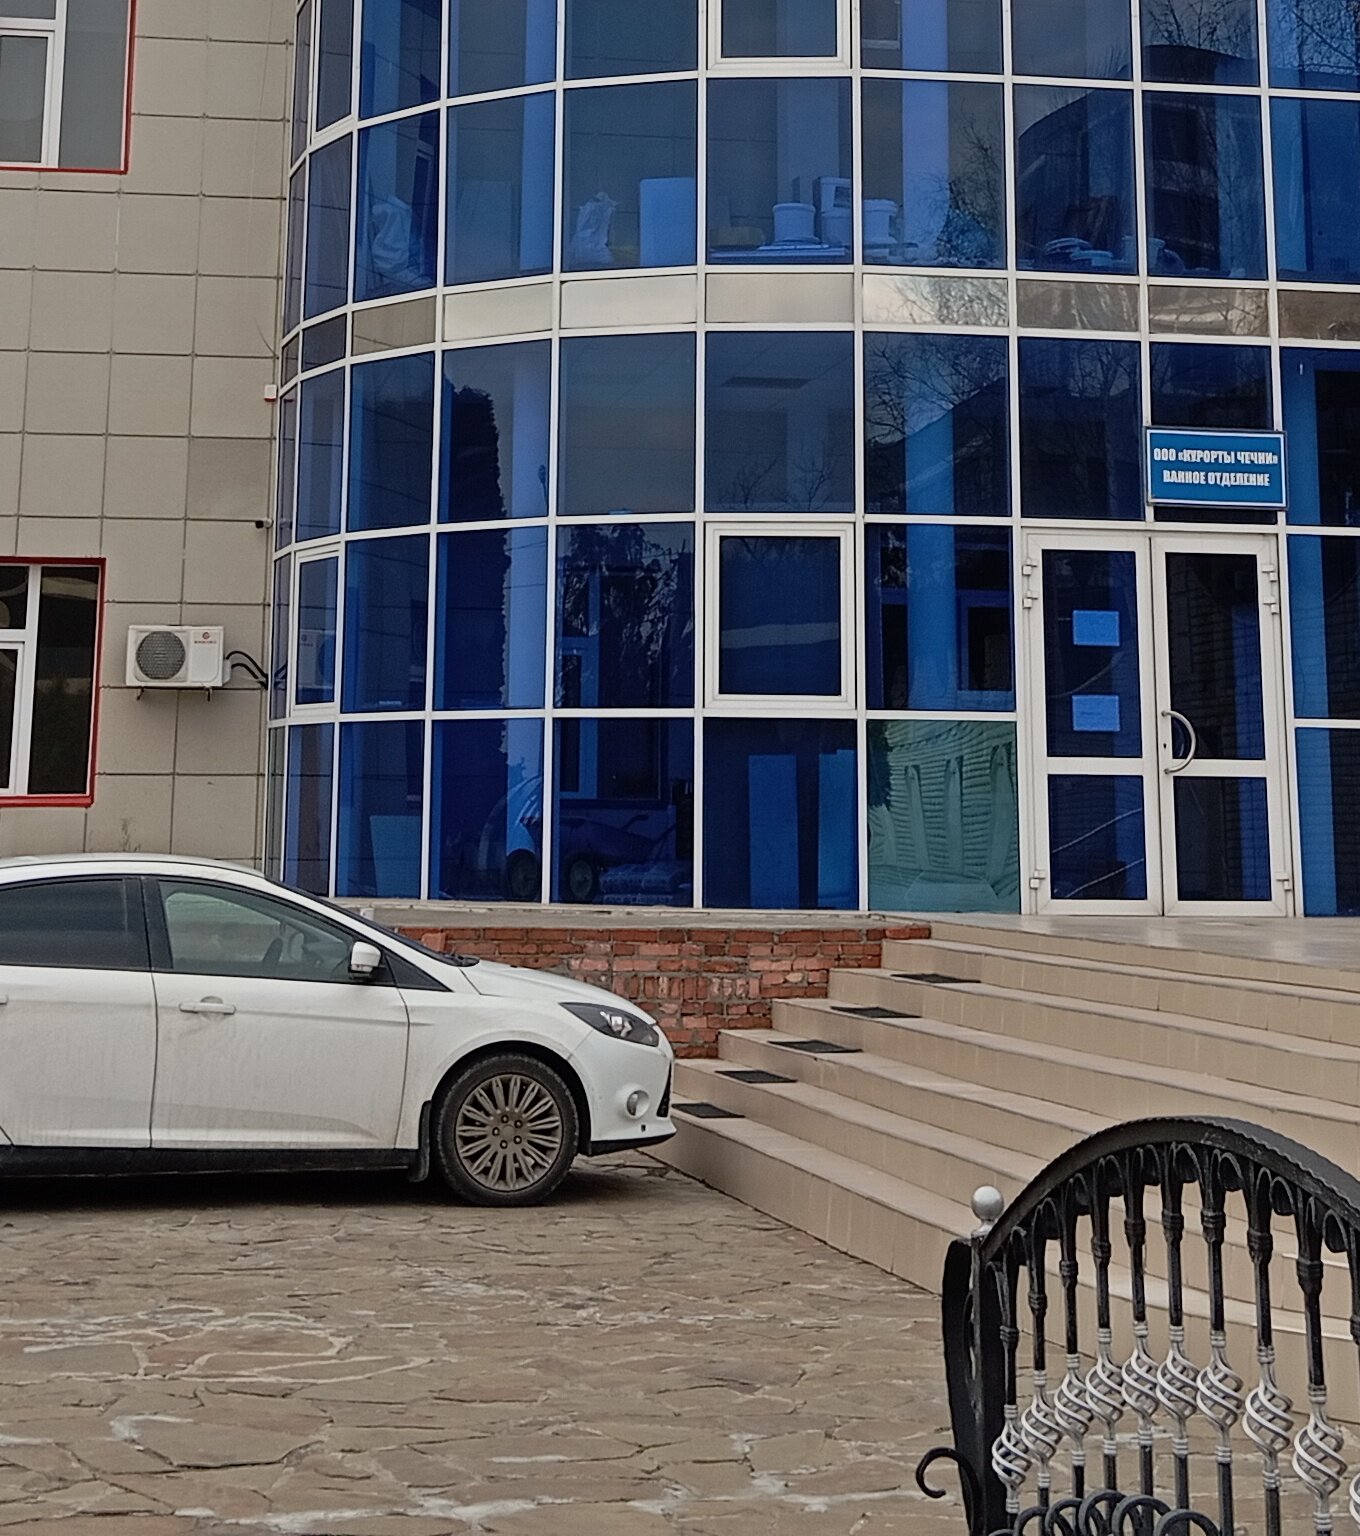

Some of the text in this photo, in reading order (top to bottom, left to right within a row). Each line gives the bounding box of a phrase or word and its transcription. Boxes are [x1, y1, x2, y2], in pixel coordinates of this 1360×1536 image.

[1153, 448, 1278, 464] ООО «КУРОРТЫ ЧЕЧНИ»
[1163, 470, 1270, 487] ВАННОЕ ОТДЕЛЕНИЕ
